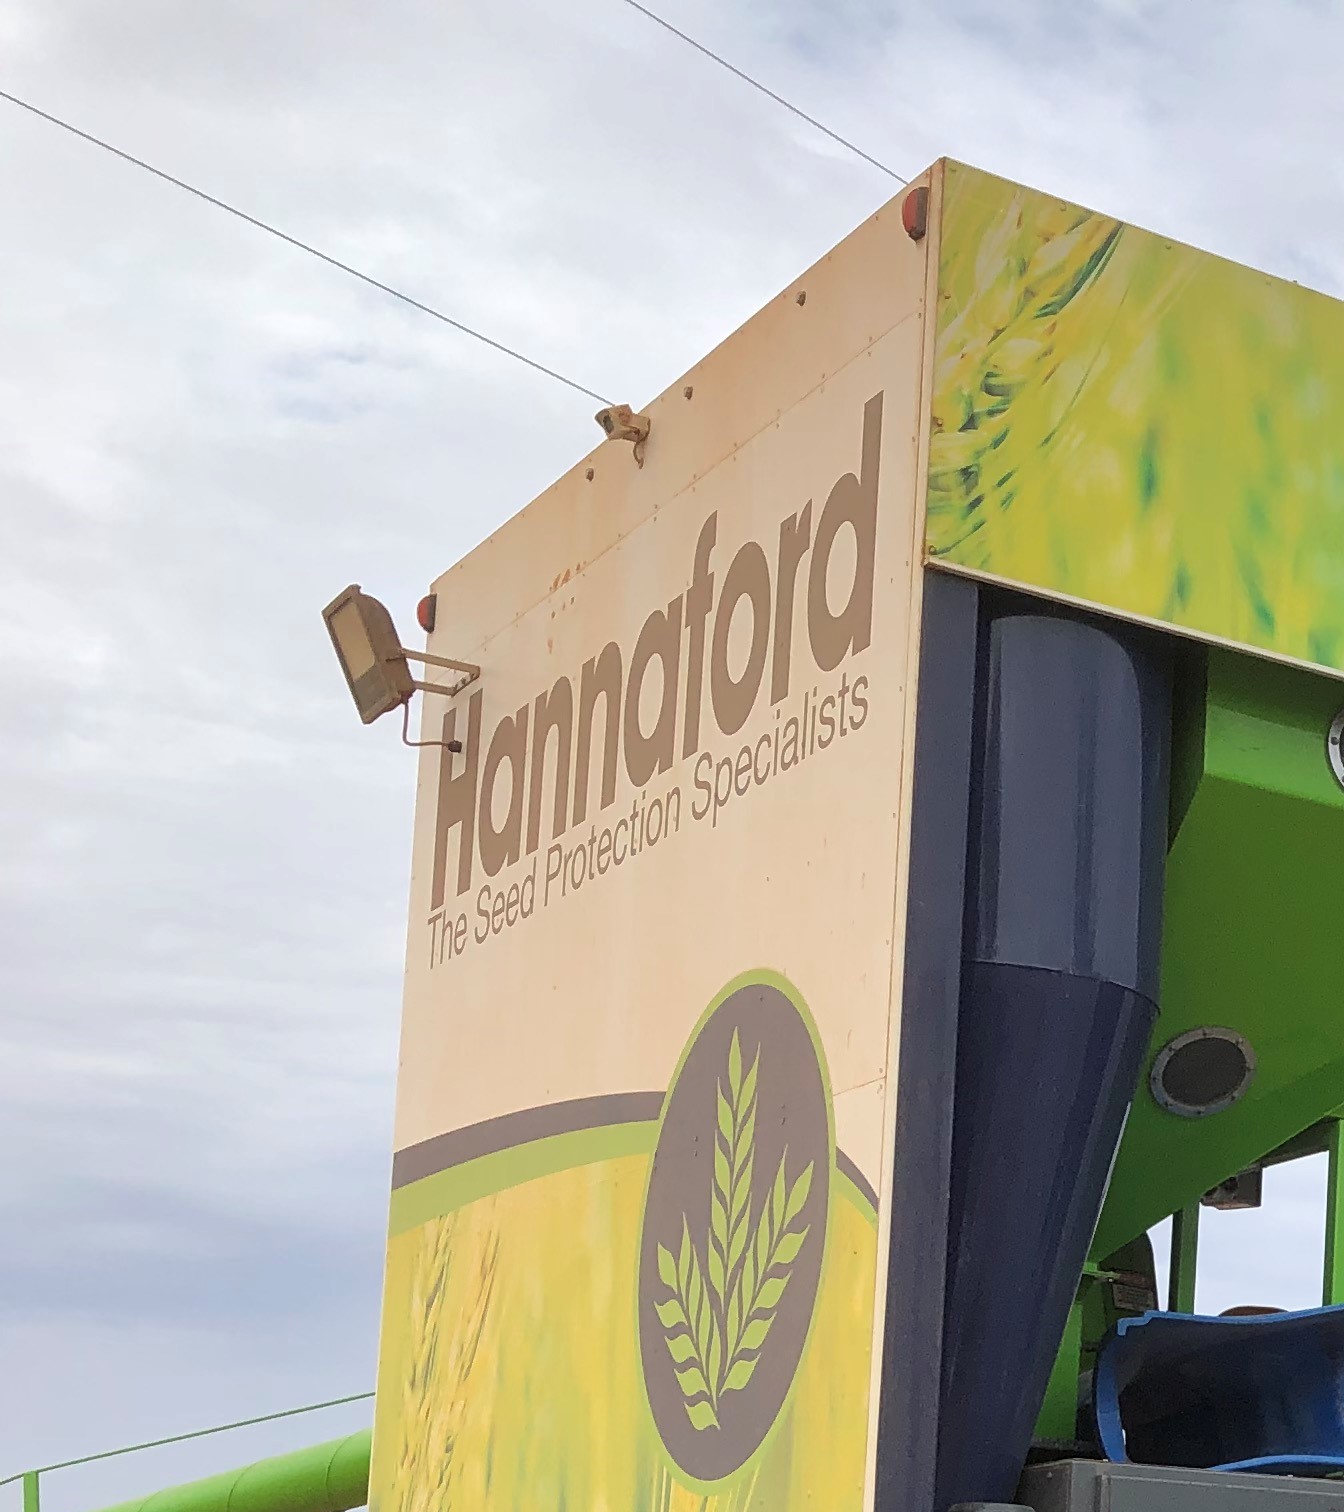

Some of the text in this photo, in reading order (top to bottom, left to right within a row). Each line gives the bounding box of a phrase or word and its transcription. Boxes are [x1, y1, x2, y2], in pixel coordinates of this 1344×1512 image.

[426, 672, 870, 970] The Seed Protection Specialists
[431, 389, 885, 911] Hannaford
